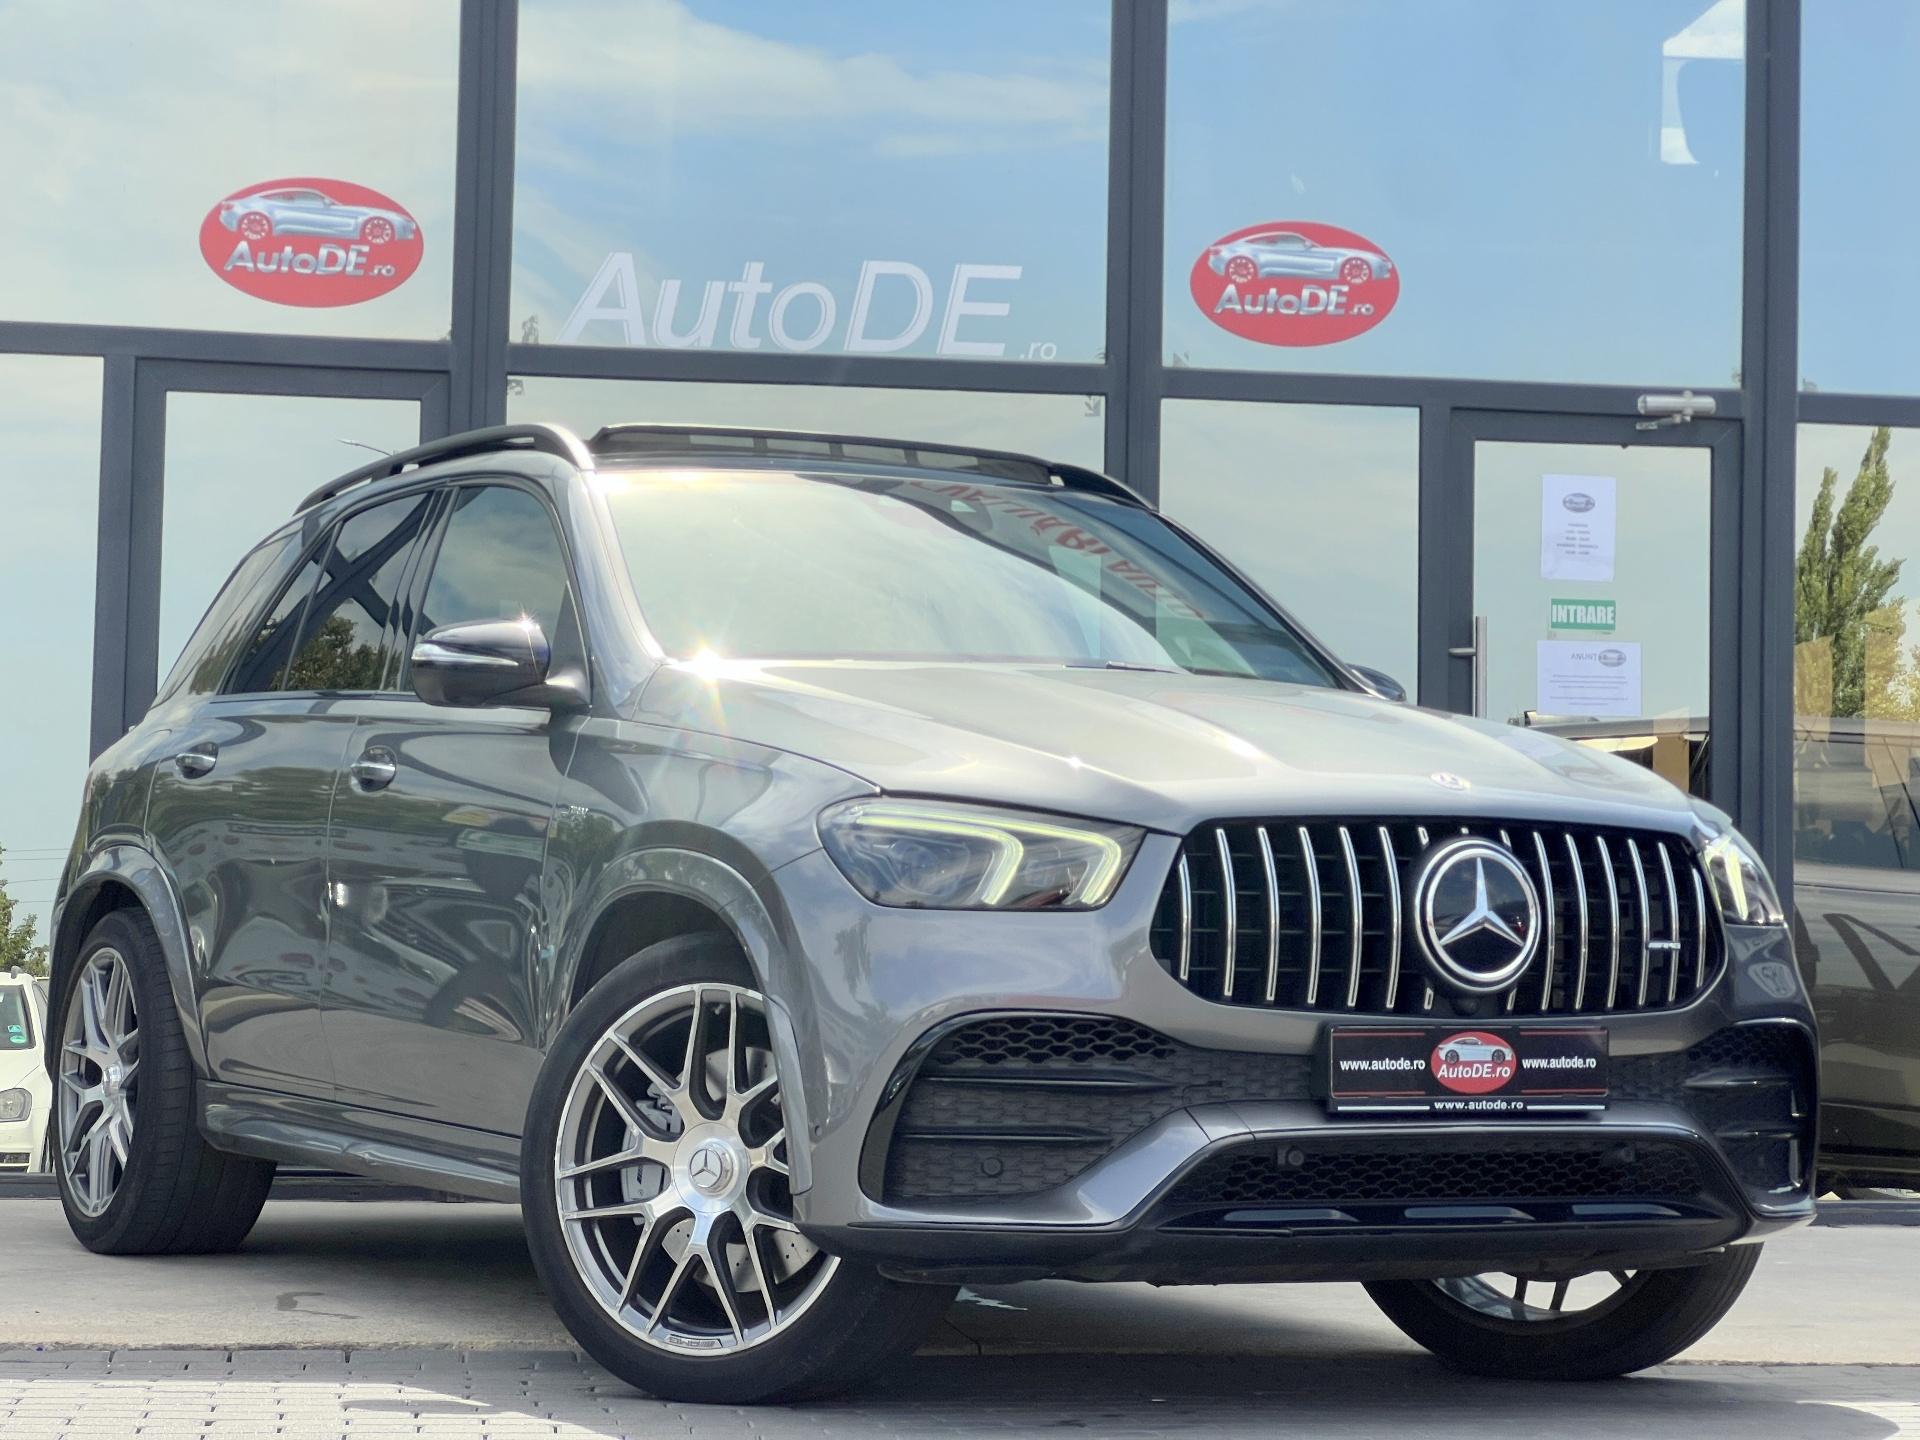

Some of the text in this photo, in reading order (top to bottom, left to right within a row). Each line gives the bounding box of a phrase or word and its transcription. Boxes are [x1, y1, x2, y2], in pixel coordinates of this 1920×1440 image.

[1551, 604, 1615, 624] INTRARE
[1340, 1057, 1426, 1071] www.autode.ro
[1522, 1055, 1597, 1069] www.autode.ro
[1437, 1063, 1511, 1079] AutoDE.ro
[1434, 1100, 1524, 1110] www.autode.ro
